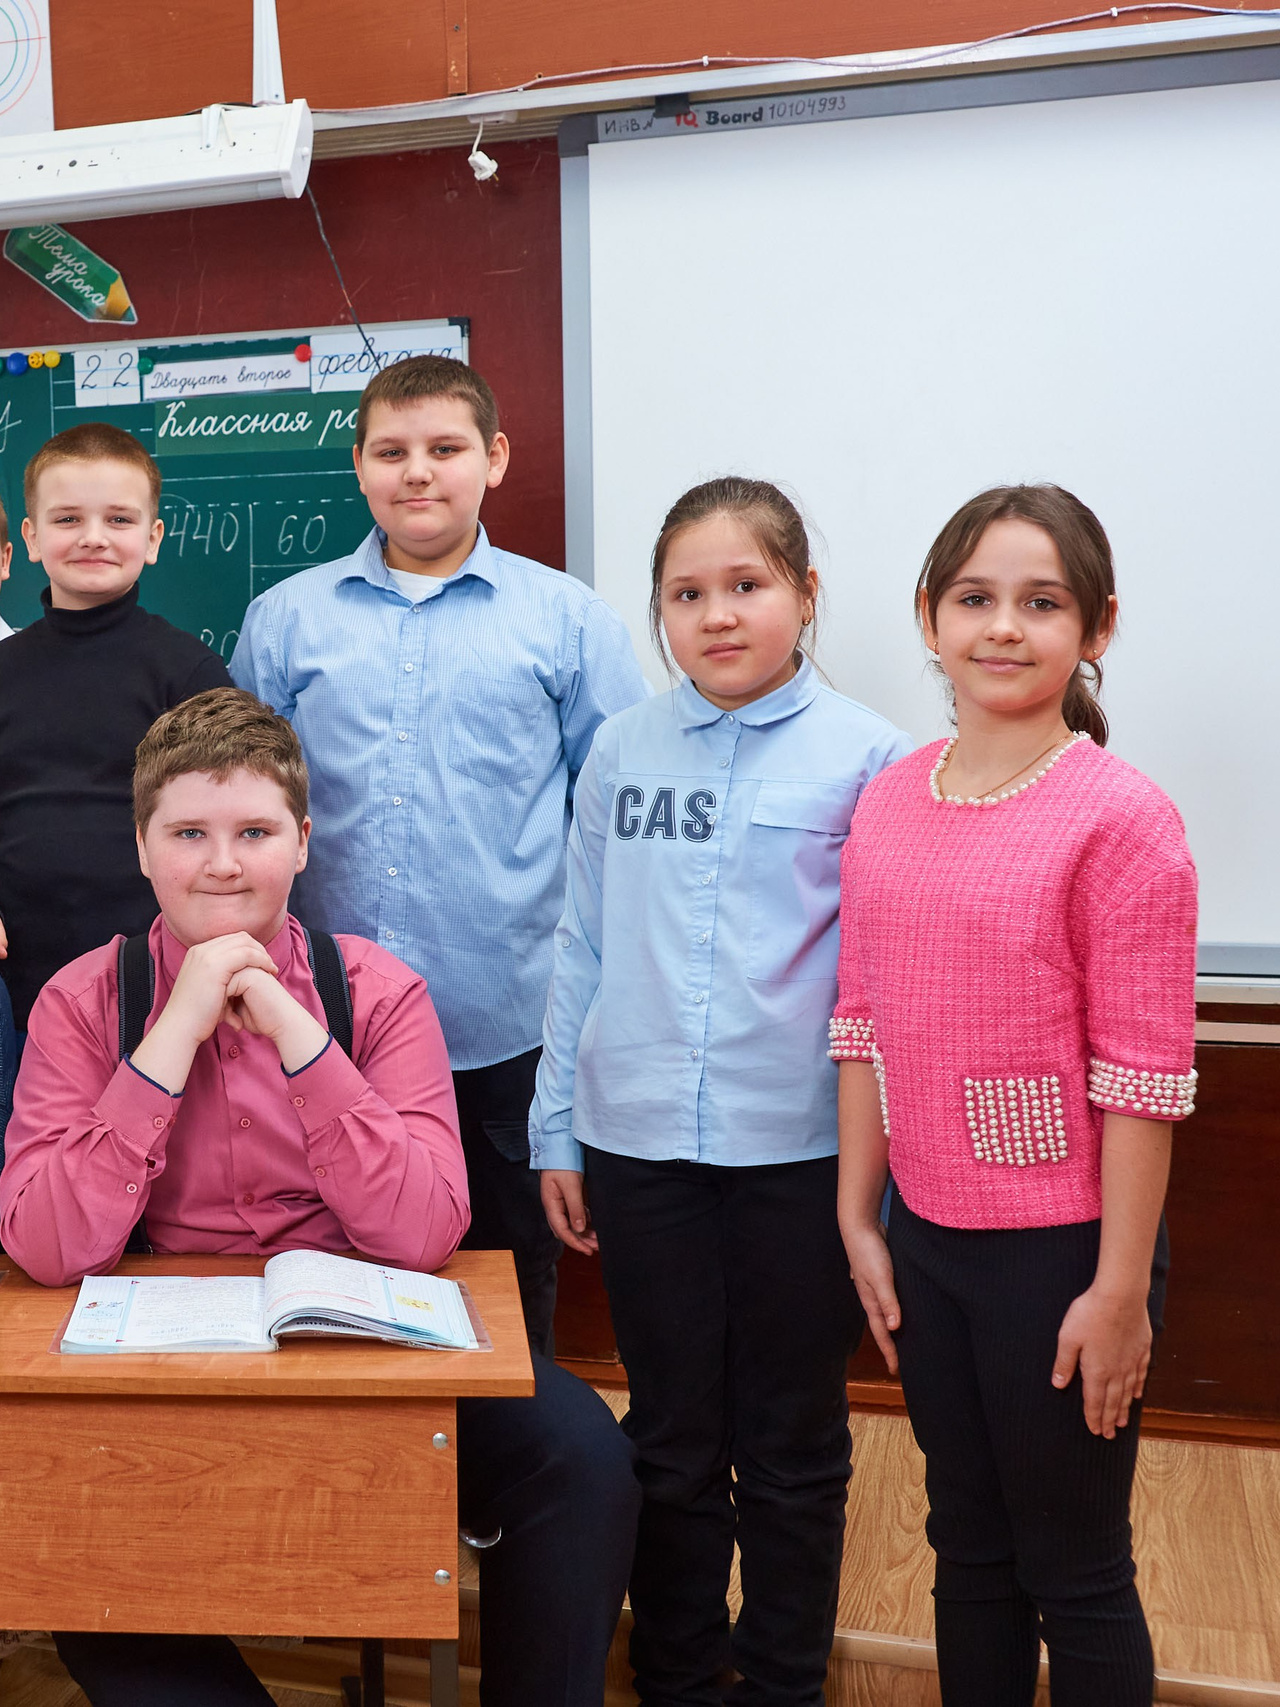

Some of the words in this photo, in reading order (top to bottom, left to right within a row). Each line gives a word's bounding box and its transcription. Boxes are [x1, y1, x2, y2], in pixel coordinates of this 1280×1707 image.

[705, 106, 763, 125] Board
[768, 96, 847, 120] 10104993
[28, 223, 88, 276] Тема
[45, 262, 106, 307] урока
[150, 371, 228, 394] Двадцать
[237, 365, 292, 388] второе
[157, 400, 313, 438] Классная
[278, 514, 326, 555] 60
[614, 784, 717, 843] CAS
